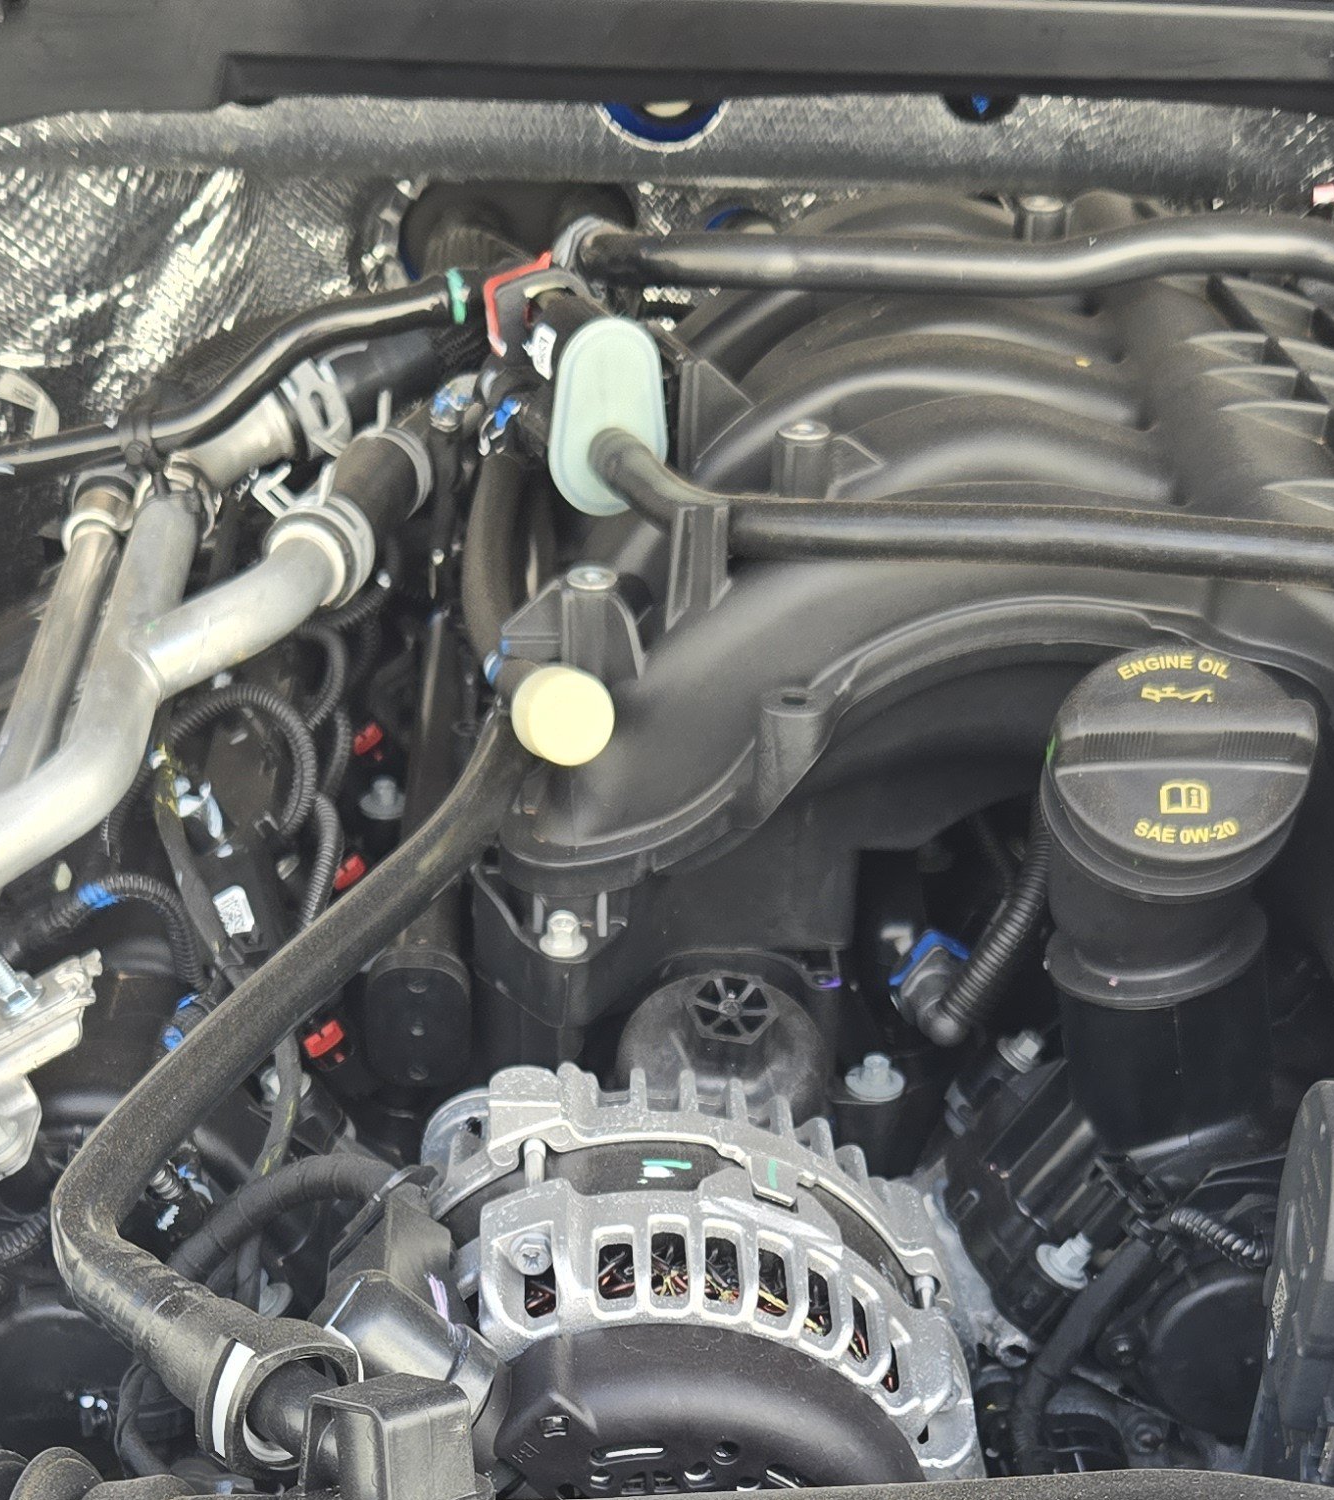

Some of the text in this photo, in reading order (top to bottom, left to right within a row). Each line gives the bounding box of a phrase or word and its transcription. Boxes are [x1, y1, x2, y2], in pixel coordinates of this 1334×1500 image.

[1117, 655, 1229, 680] ENGINE OIL
[1134, 820, 1237, 845] SAE 0W-20
